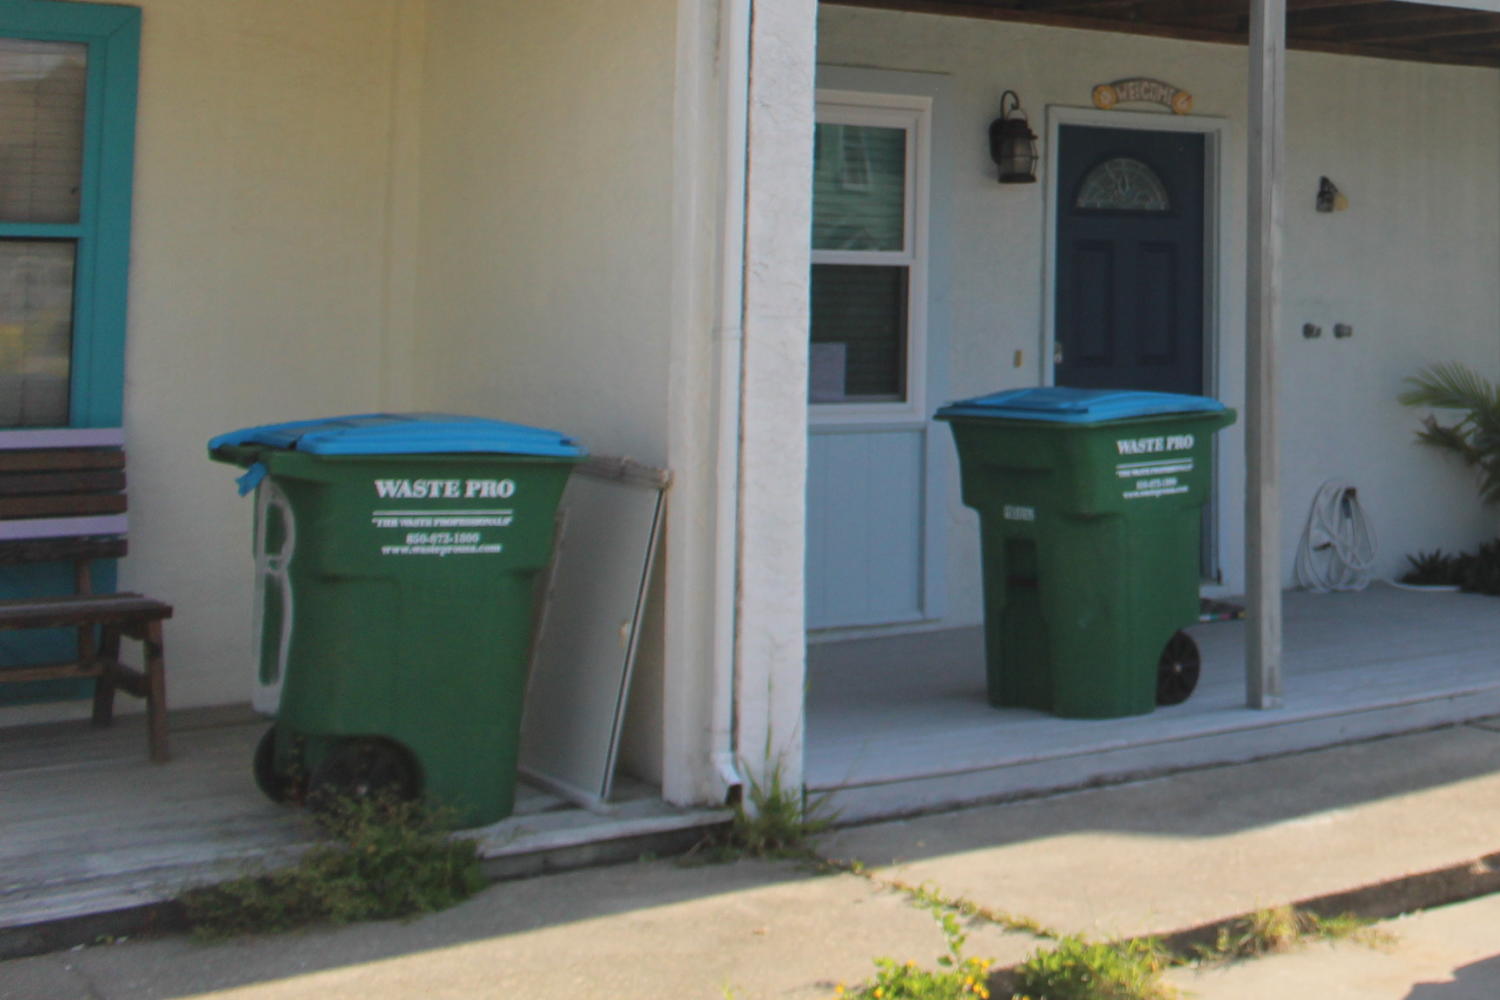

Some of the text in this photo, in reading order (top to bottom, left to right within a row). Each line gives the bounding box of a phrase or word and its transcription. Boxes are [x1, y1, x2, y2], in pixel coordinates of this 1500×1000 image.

[1117, 434, 1195, 454] WASTE PRO
[374, 479, 515, 499] WASTE PRO
